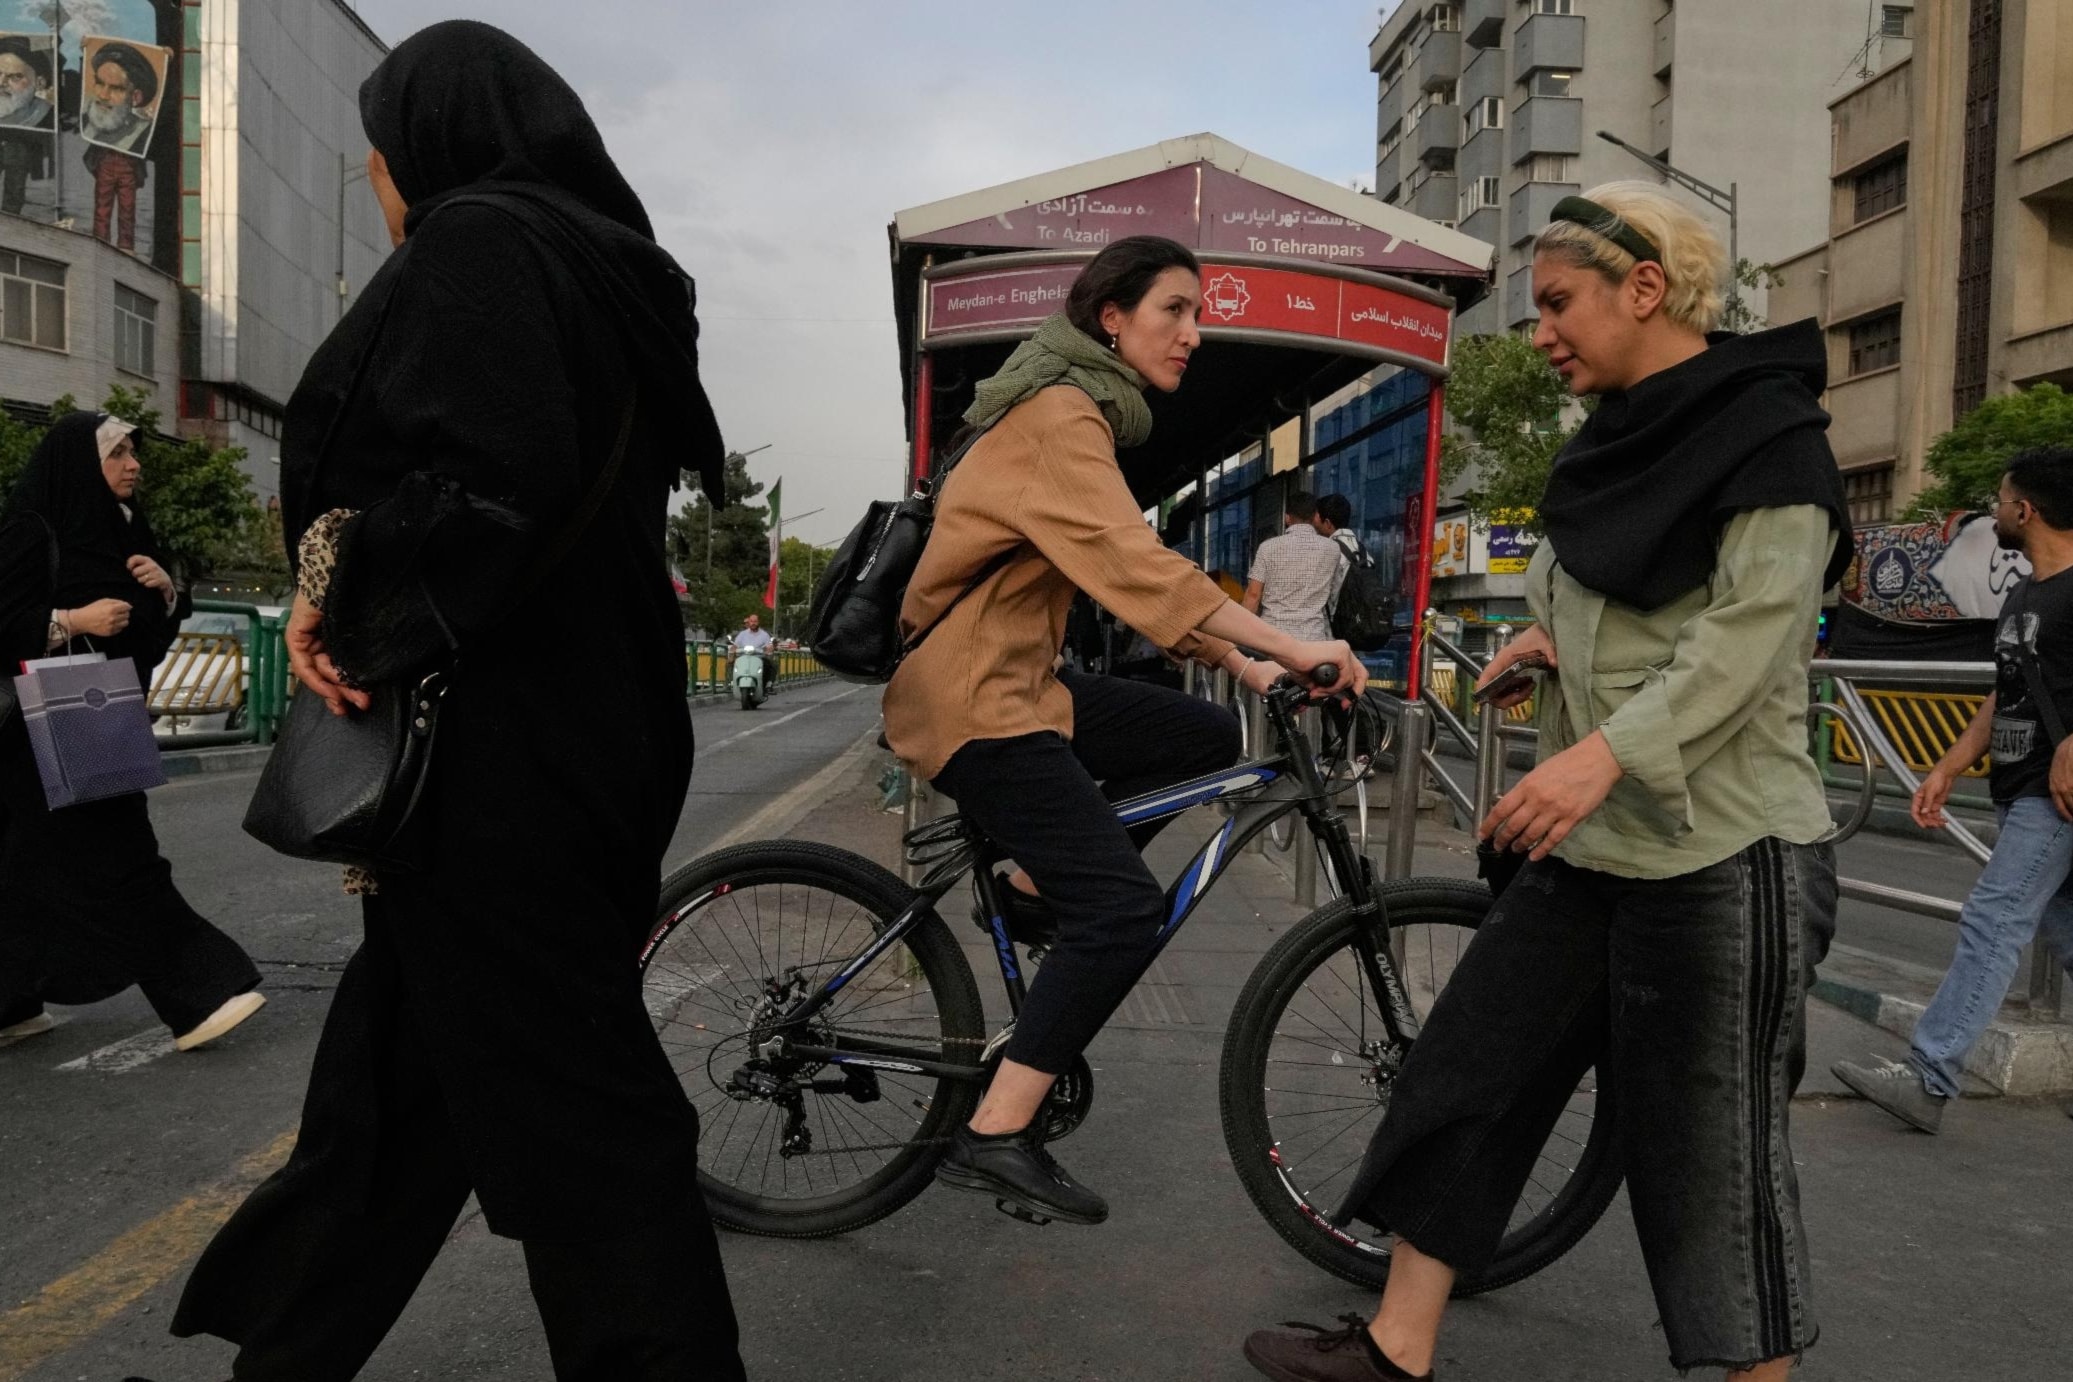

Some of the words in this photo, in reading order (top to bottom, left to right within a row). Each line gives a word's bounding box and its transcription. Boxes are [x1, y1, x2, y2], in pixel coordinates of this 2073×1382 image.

[1036, 195, 1087, 216] آزادی
[1088, 200, 1132, 216] سمت
[1303, 211, 1344, 227] سمت
[1036, 225, 1057, 241] To
[1063, 227, 1110, 243] Azadi
[1247, 236, 1267, 252] To
[1272, 238, 1365, 259] Tehranpars
[947, 293, 1006, 312] Meydan-e
[1351, 307, 1389, 324] اسلامی
[1390, 312, 1419, 332] انقلاب
[1420, 323, 1443, 340] میدان
[1314, 1214, 1333, 1230] CYCLE
[1334, 1228, 1355, 1243] POWER
